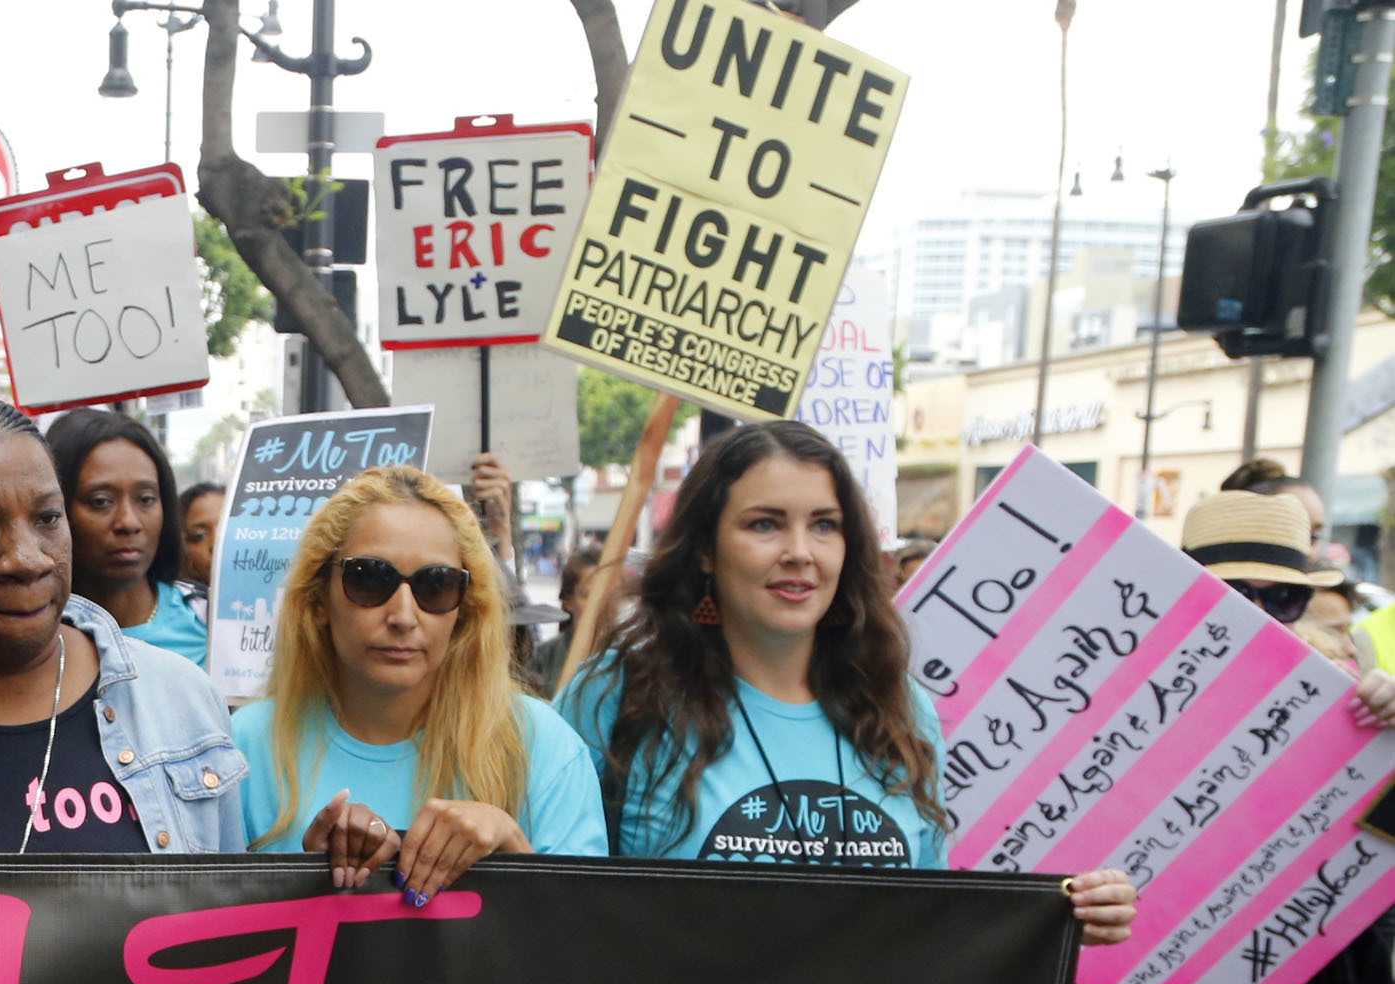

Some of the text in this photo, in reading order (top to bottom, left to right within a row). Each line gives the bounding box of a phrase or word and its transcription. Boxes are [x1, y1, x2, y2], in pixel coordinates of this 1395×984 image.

[661, 0, 895, 147] UNITE
[390, 157, 566, 218] FREE
[710, 117, 791, 199] TO
[27, 238, 113, 311] ME
[413, 220, 555, 269] ERIC
[608, 178, 829, 304] FIGHT
[21, 286, 180, 369] TOO!
[396, 280, 523, 326] LYLE
[574, 238, 819, 359] PATRIARCHY
[570, 293, 797, 393] PEOPLE'S CONGRESS
[590, 328, 760, 407] OF RESISTANCE
[245, 475, 343, 494] survivors'
[233, 548, 292, 584] Hollywo
[235, 527, 268, 541] Nov
[921, 657, 960, 699] e
[944, 738, 1008, 831] ain
[1005, 623, 1139, 734] Again
[990, 820, 1057, 873] gain
[1057, 730, 1144, 813] Again
[1147, 644, 1231, 726] Again
[714, 834, 905, 857] survivors' march
[1123, 836, 1179, 891] gain
[1172, 764, 1249, 829] Again
